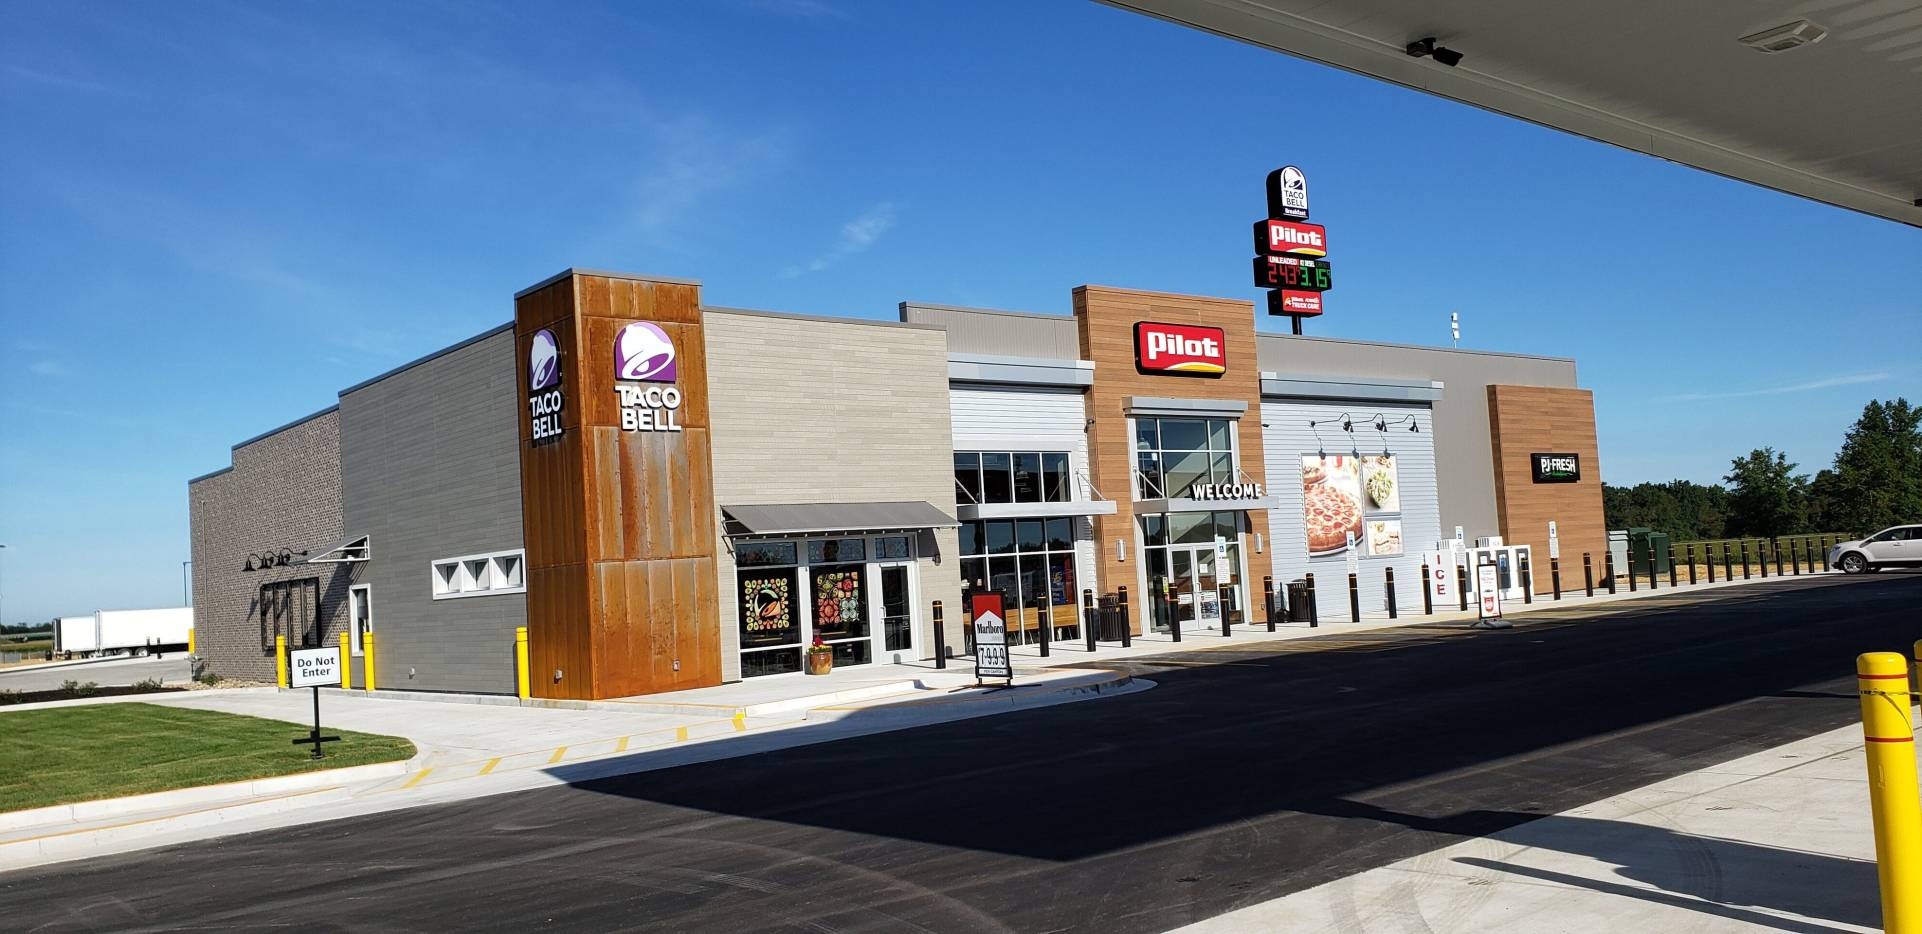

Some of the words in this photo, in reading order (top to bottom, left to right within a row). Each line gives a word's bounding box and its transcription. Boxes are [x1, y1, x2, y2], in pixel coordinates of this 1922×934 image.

[1284, 190, 1304, 199] TACO
[1286, 198, 1305, 207] BELL
[1271, 225, 1322, 246] Pilot
[1147, 331, 1221, 360] Pilot
[530, 390, 562, 417] TACO
[614, 385, 681, 409] TACO
[533, 414, 562, 439] BELL
[621, 408, 682, 432] BELL
[1192, 483, 1263, 499] WELCOME
[1435, 554, 1446, 595] ICE
[977, 621, 1004, 634] Marlboro
[297, 658, 312, 667] Do
[315, 656, 335, 666] Not
[302, 668, 331, 677] Enter
